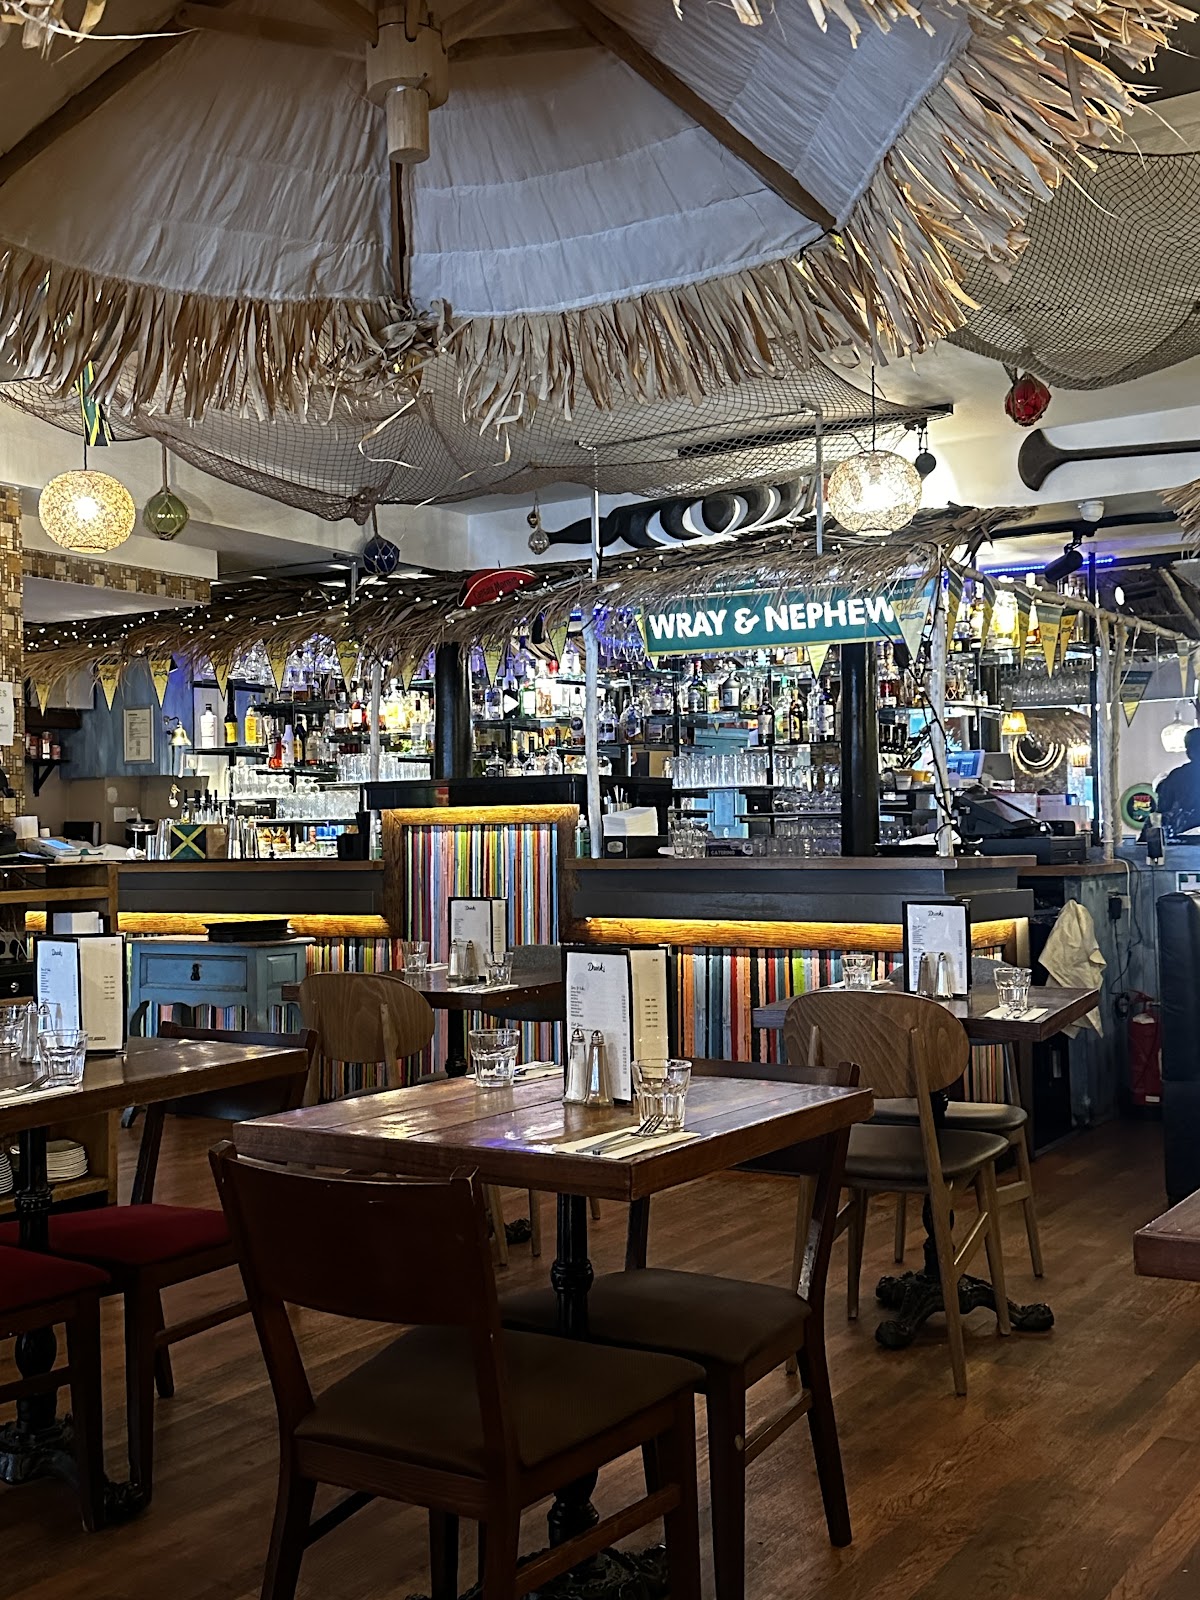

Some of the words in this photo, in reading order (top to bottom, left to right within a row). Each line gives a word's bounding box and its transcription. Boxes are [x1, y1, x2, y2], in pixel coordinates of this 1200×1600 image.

[648, 609, 728, 640] WRAY
[734, 606, 760, 635] &
[764, 597, 895, 632] NEPHEW
